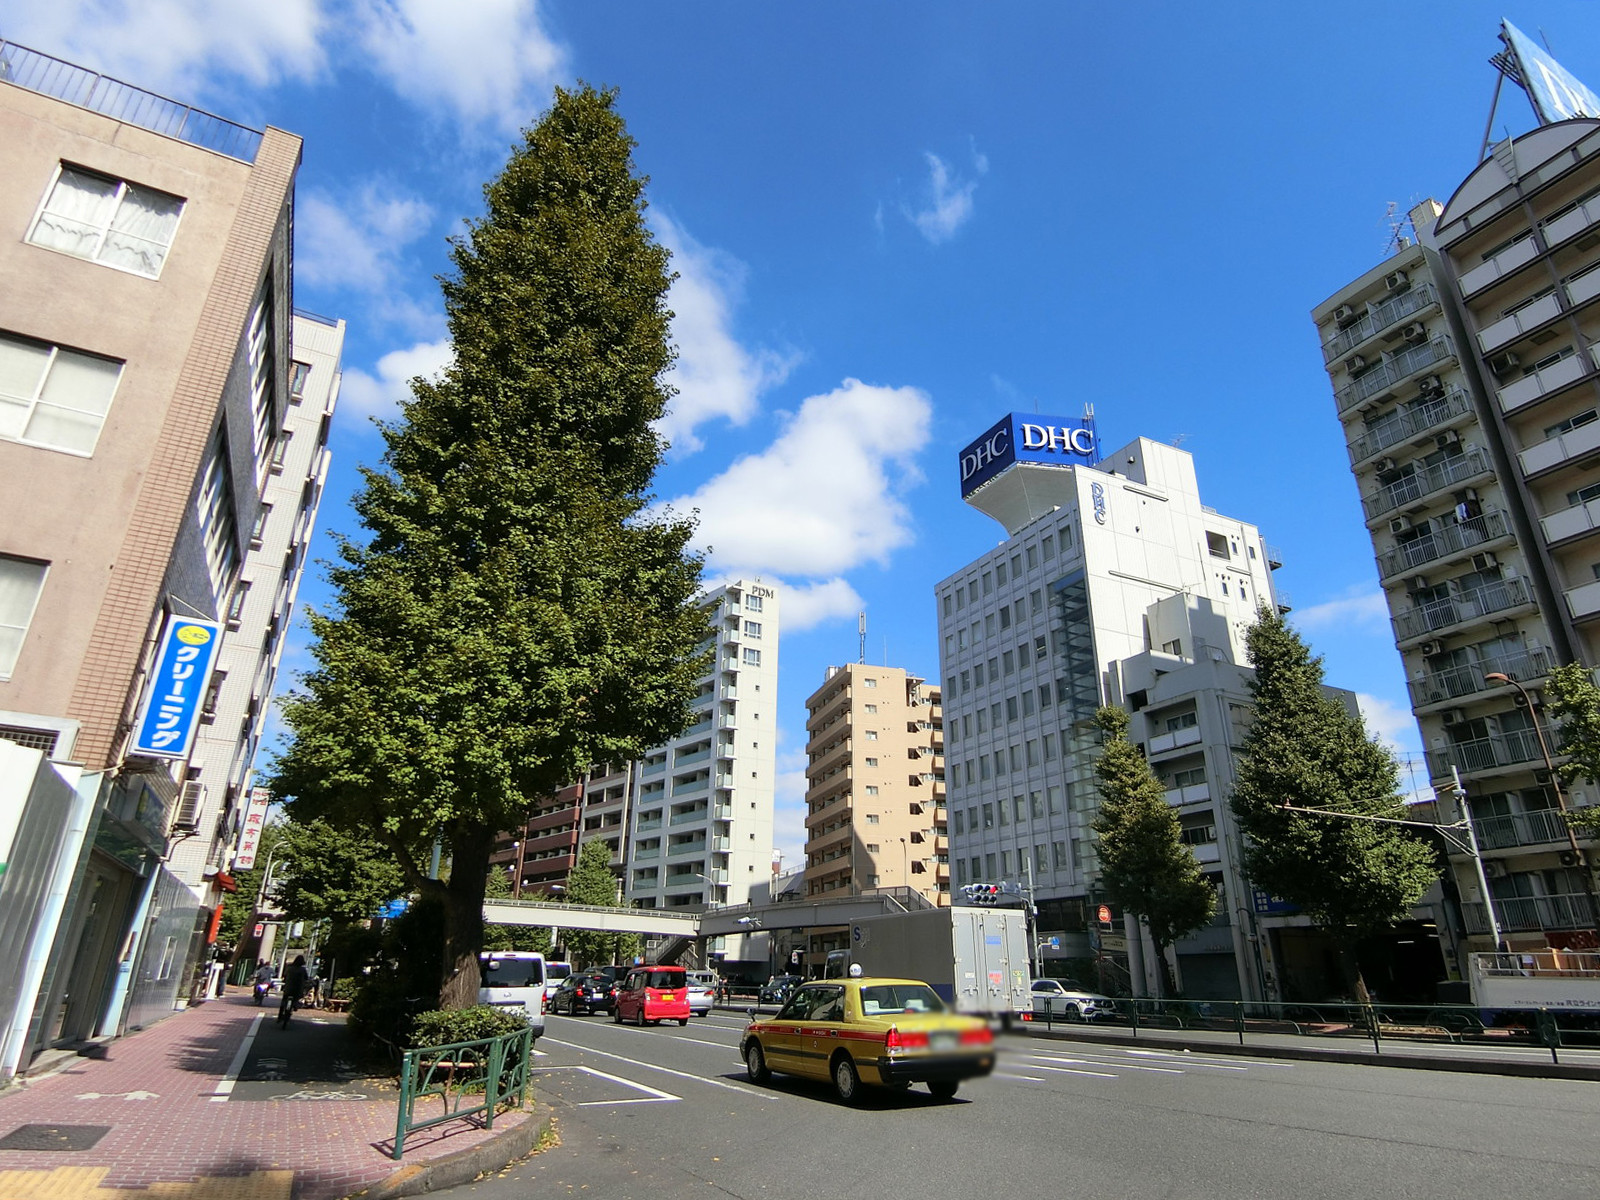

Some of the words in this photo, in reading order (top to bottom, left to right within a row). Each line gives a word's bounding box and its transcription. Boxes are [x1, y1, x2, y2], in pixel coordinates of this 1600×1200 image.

[961, 427, 1008, 481] DHC
[1022, 423, 1095, 453] DHC
[1091, 481, 1107, 525] DHC
[752, 585, 774, 599] PDM
[150, 646, 200, 748] クリーニング
